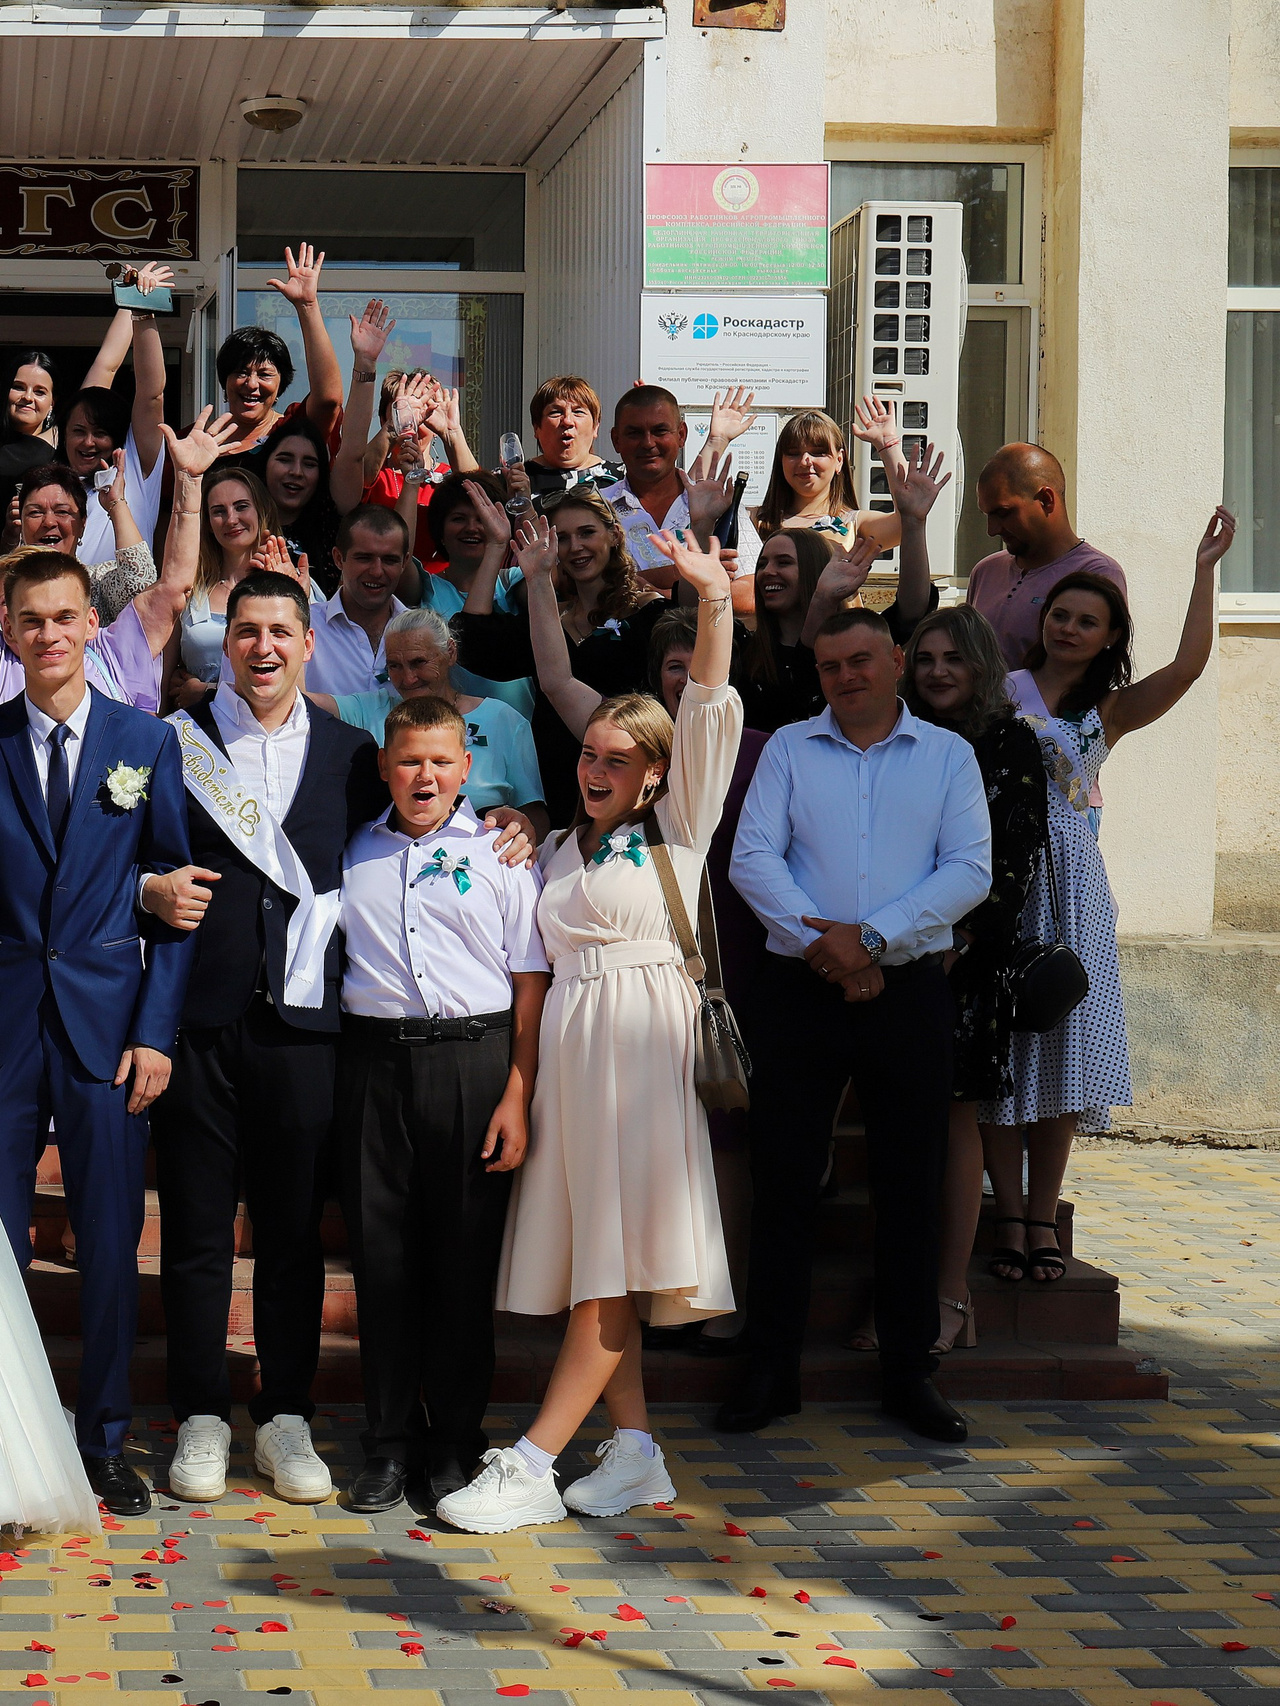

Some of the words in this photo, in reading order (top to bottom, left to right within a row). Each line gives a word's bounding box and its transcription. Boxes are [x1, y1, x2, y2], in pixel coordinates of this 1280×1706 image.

[723, 316, 805, 331] Роскадастр
[732, 331, 791, 339] Краснодарскому
[680, 376, 739, 384] публично-правовой
[182, 722, 236, 816] свидетель
